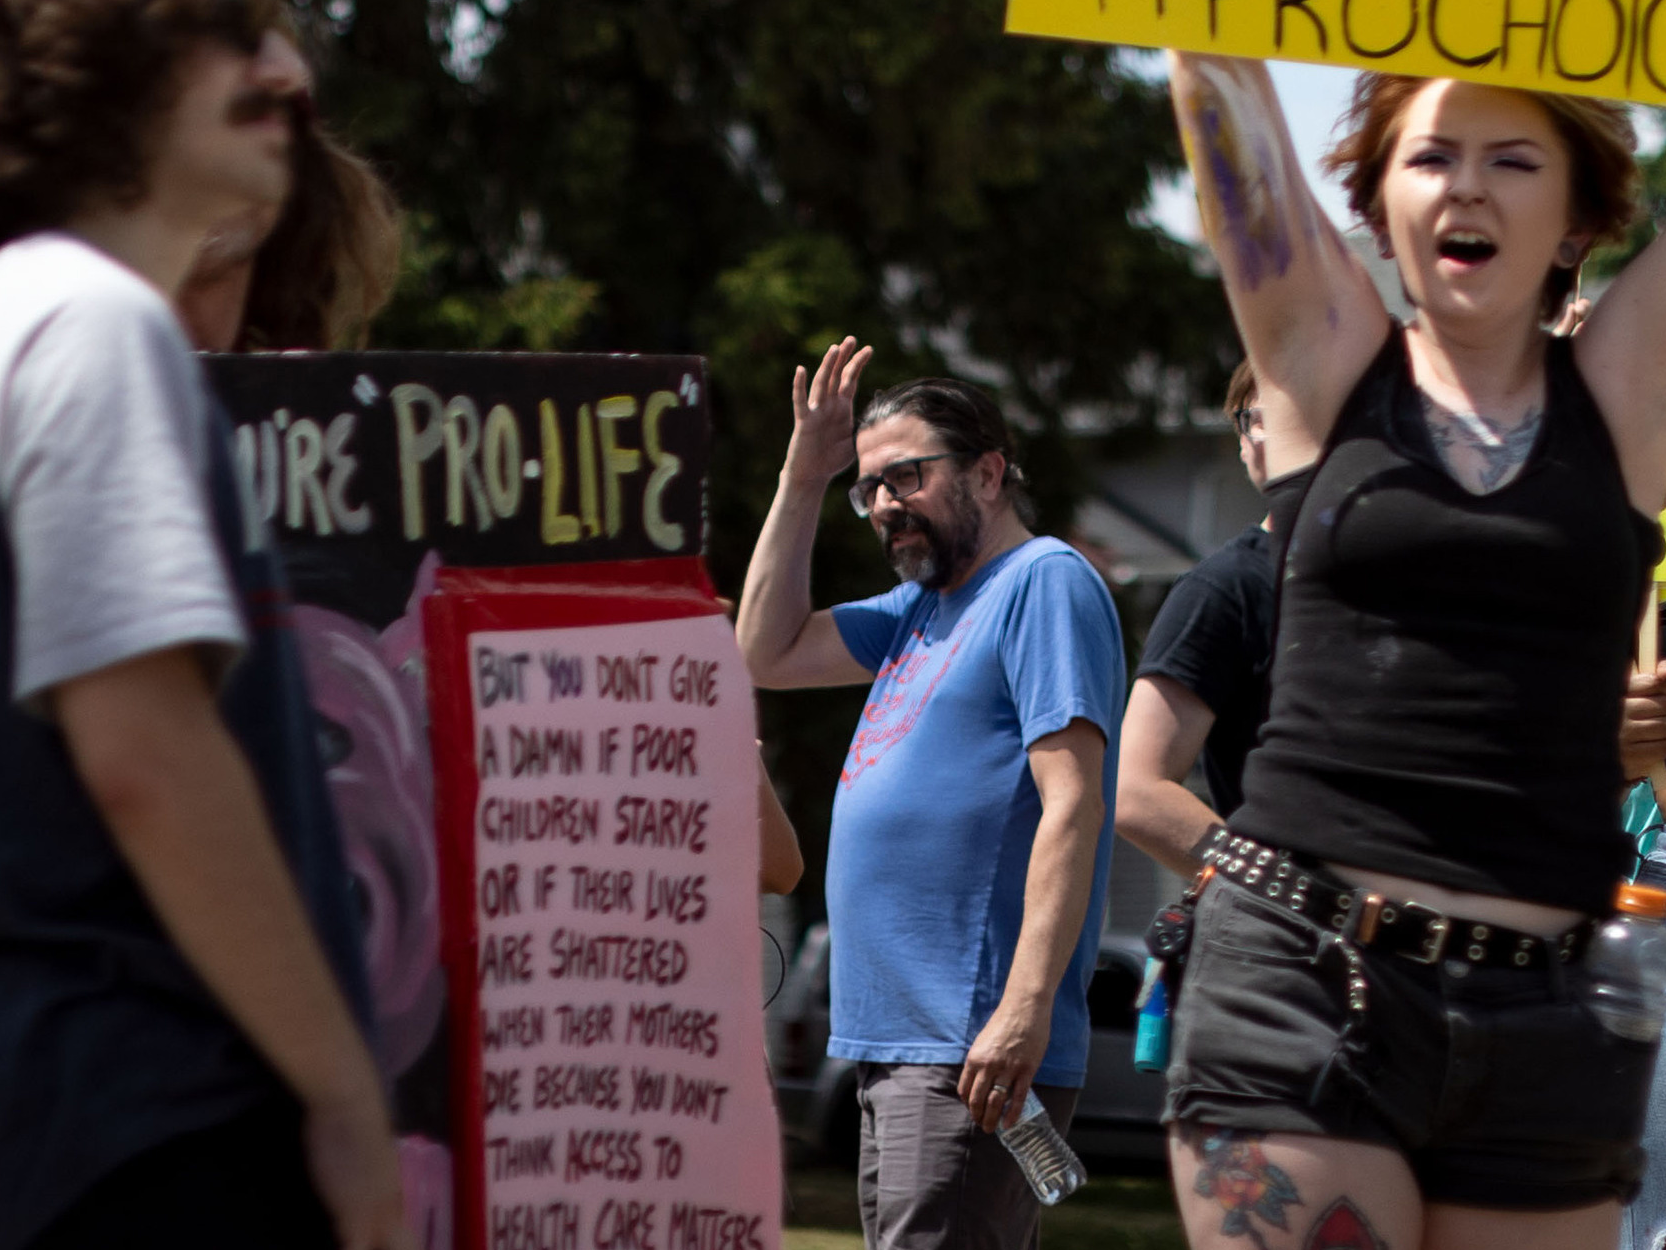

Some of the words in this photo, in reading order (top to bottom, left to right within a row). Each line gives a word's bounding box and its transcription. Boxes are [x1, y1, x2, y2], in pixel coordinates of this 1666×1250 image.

[478, 646, 530, 709] BUT
[540, 649, 582, 703] YOU
[670, 654, 719, 707] GIVE
[481, 724, 500, 780] A
[510, 723, 583, 779] DAMN
[598, 726, 619, 775] IF
[632, 723, 697, 777] POOR
[483, 796, 598, 846] CHILDREN
[614, 795, 710, 854] STARVE
[482, 863, 520, 919] OR
[536, 864, 557, 911] IF
[570, 865, 633, 914] THEIR
[645, 869, 706, 924] LIVES
[480, 932, 533, 990] ARE
[548, 927, 688, 987] SHATTERED
[481, 1006, 544, 1053] WHEN
[625, 1003, 718, 1058] MOTHERS
[484, 1069, 521, 1117] DIE
[534, 1065, 621, 1111] BECAUSE
[632, 1066, 666, 1115] YOU
[487, 1136, 553, 1182] THINK
[564, 1128, 642, 1183] ACCESS
[653, 1136, 682, 1180] TO
[492, 1202, 580, 1250] HEALTH
[594, 1199, 657, 1250] CARE
[668, 1202, 763, 1250] MATTERS
